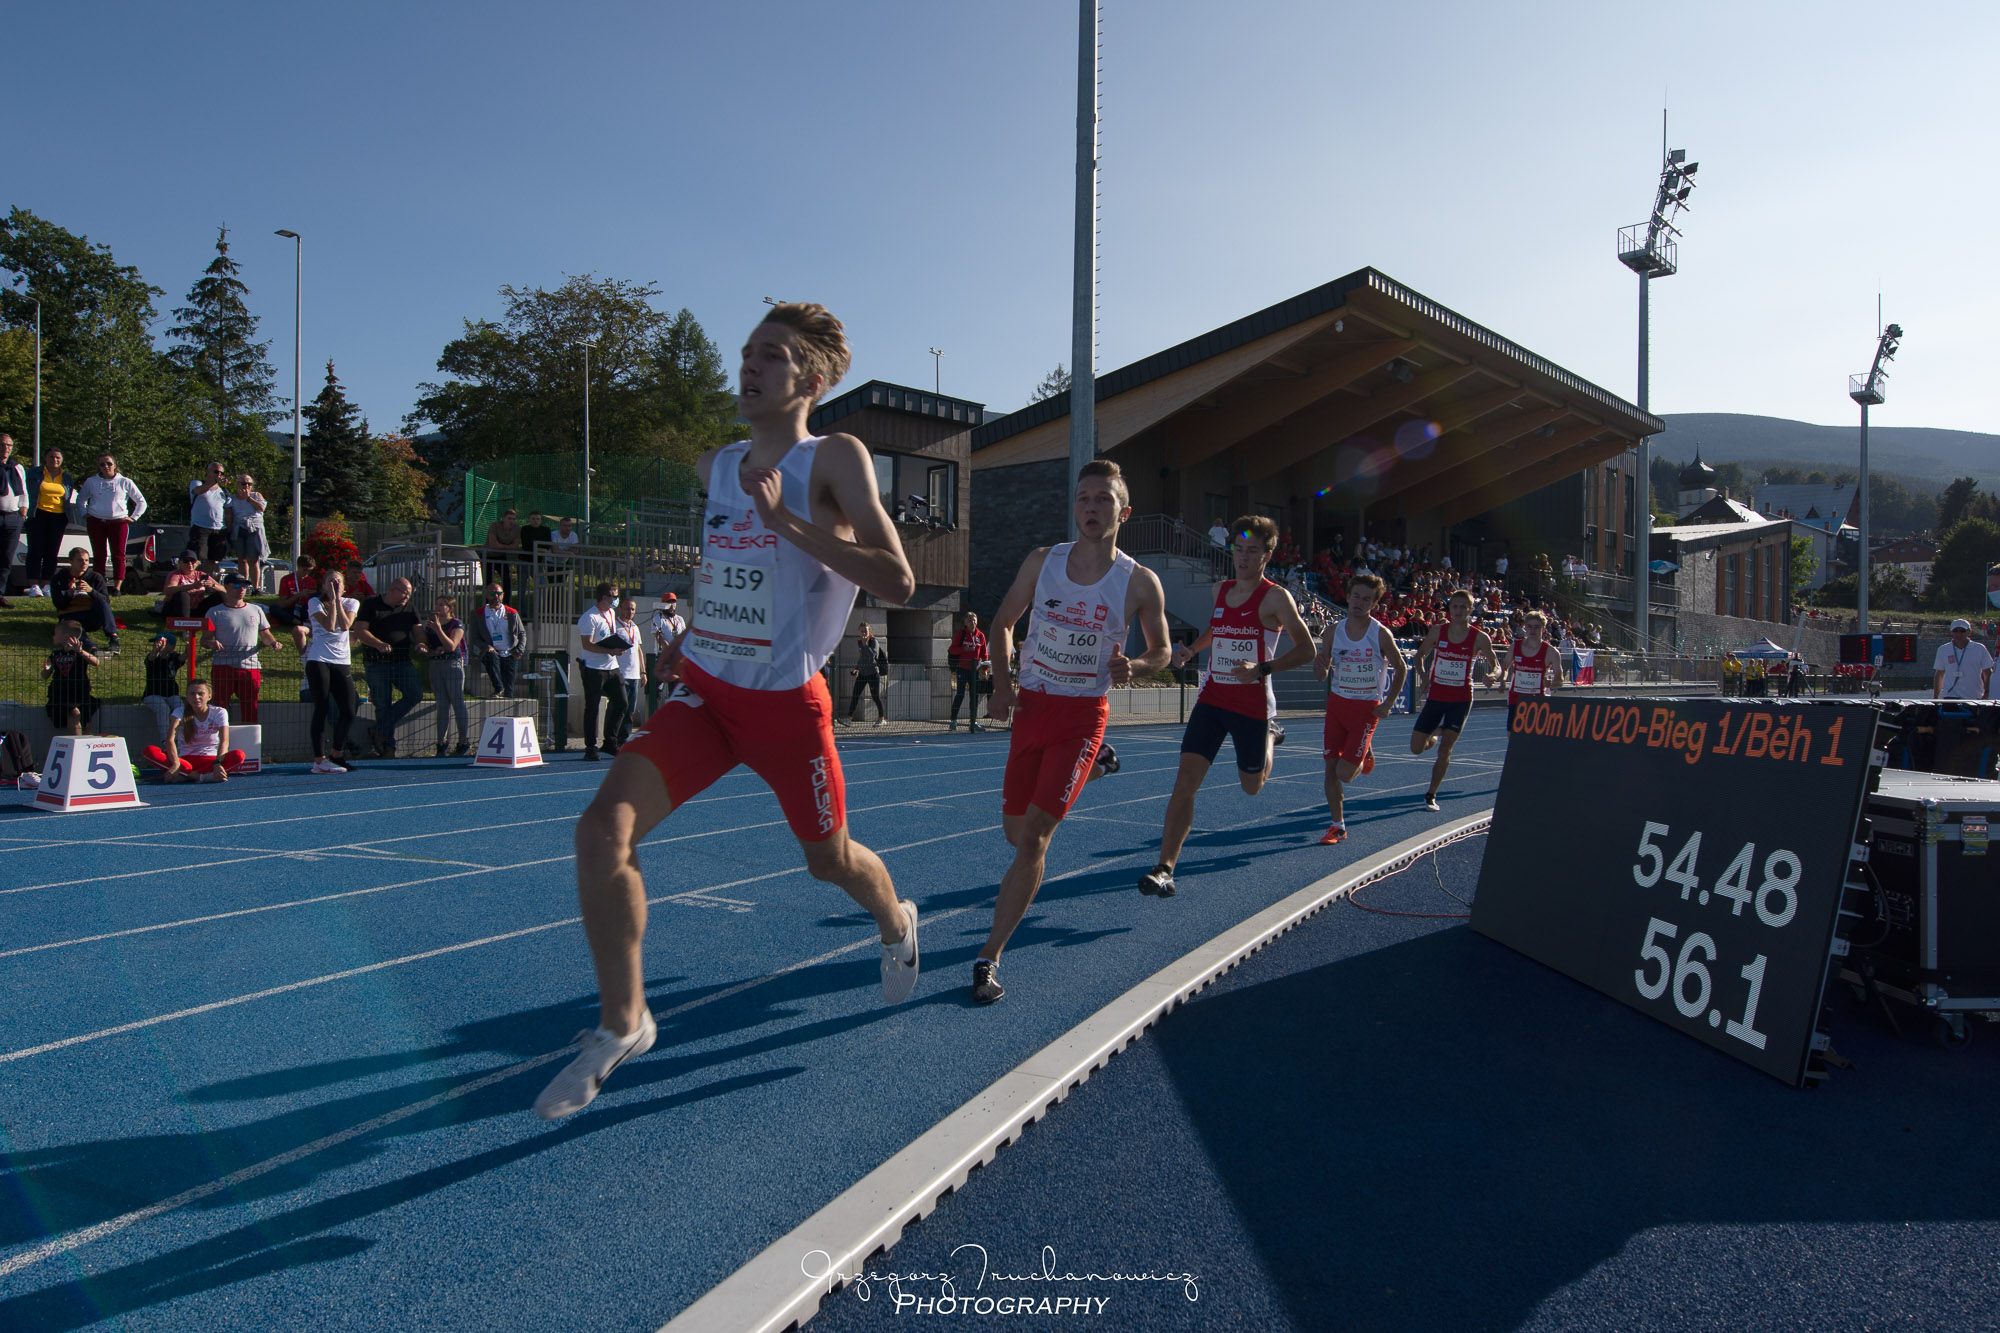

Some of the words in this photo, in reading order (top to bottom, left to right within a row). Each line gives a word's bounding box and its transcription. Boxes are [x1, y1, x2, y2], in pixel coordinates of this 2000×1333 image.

[708, 534, 778, 549] POLSKA
[723, 566, 764, 591] 159
[1044, 599, 1062, 609] 4F
[1047, 611, 1103, 632] POLSKA
[730, 645, 757, 657] 2020
[1067, 633, 1097, 647] 160
[1231, 641, 1253, 652] 560
[1037, 642, 1097, 666] MASACZYŃSKI
[1450, 661, 1464, 669] 555
[1039, 668, 1068, 683] KARPACZ
[1069, 676, 1087, 684] 2020
[1357, 663, 1374, 673] 158
[488, 726, 505, 755] 4
[520, 726, 533, 753] 4
[1512, 701, 1561, 737] 800m
[1565, 704, 1589, 740] M
[1591, 704, 1708, 765] U20-Bieg
[1712, 711, 1812, 763] 1/Běh
[1820, 716, 1844, 766] 1
[48, 750, 66, 789] 5
[87, 750, 117, 790] 5
[1059, 738, 1092, 803] POLSKA
[809, 755, 835, 835] POLSKA
[1632, 820, 1802, 929] 54.48
[1634, 916, 1768, 1051] 56.1
